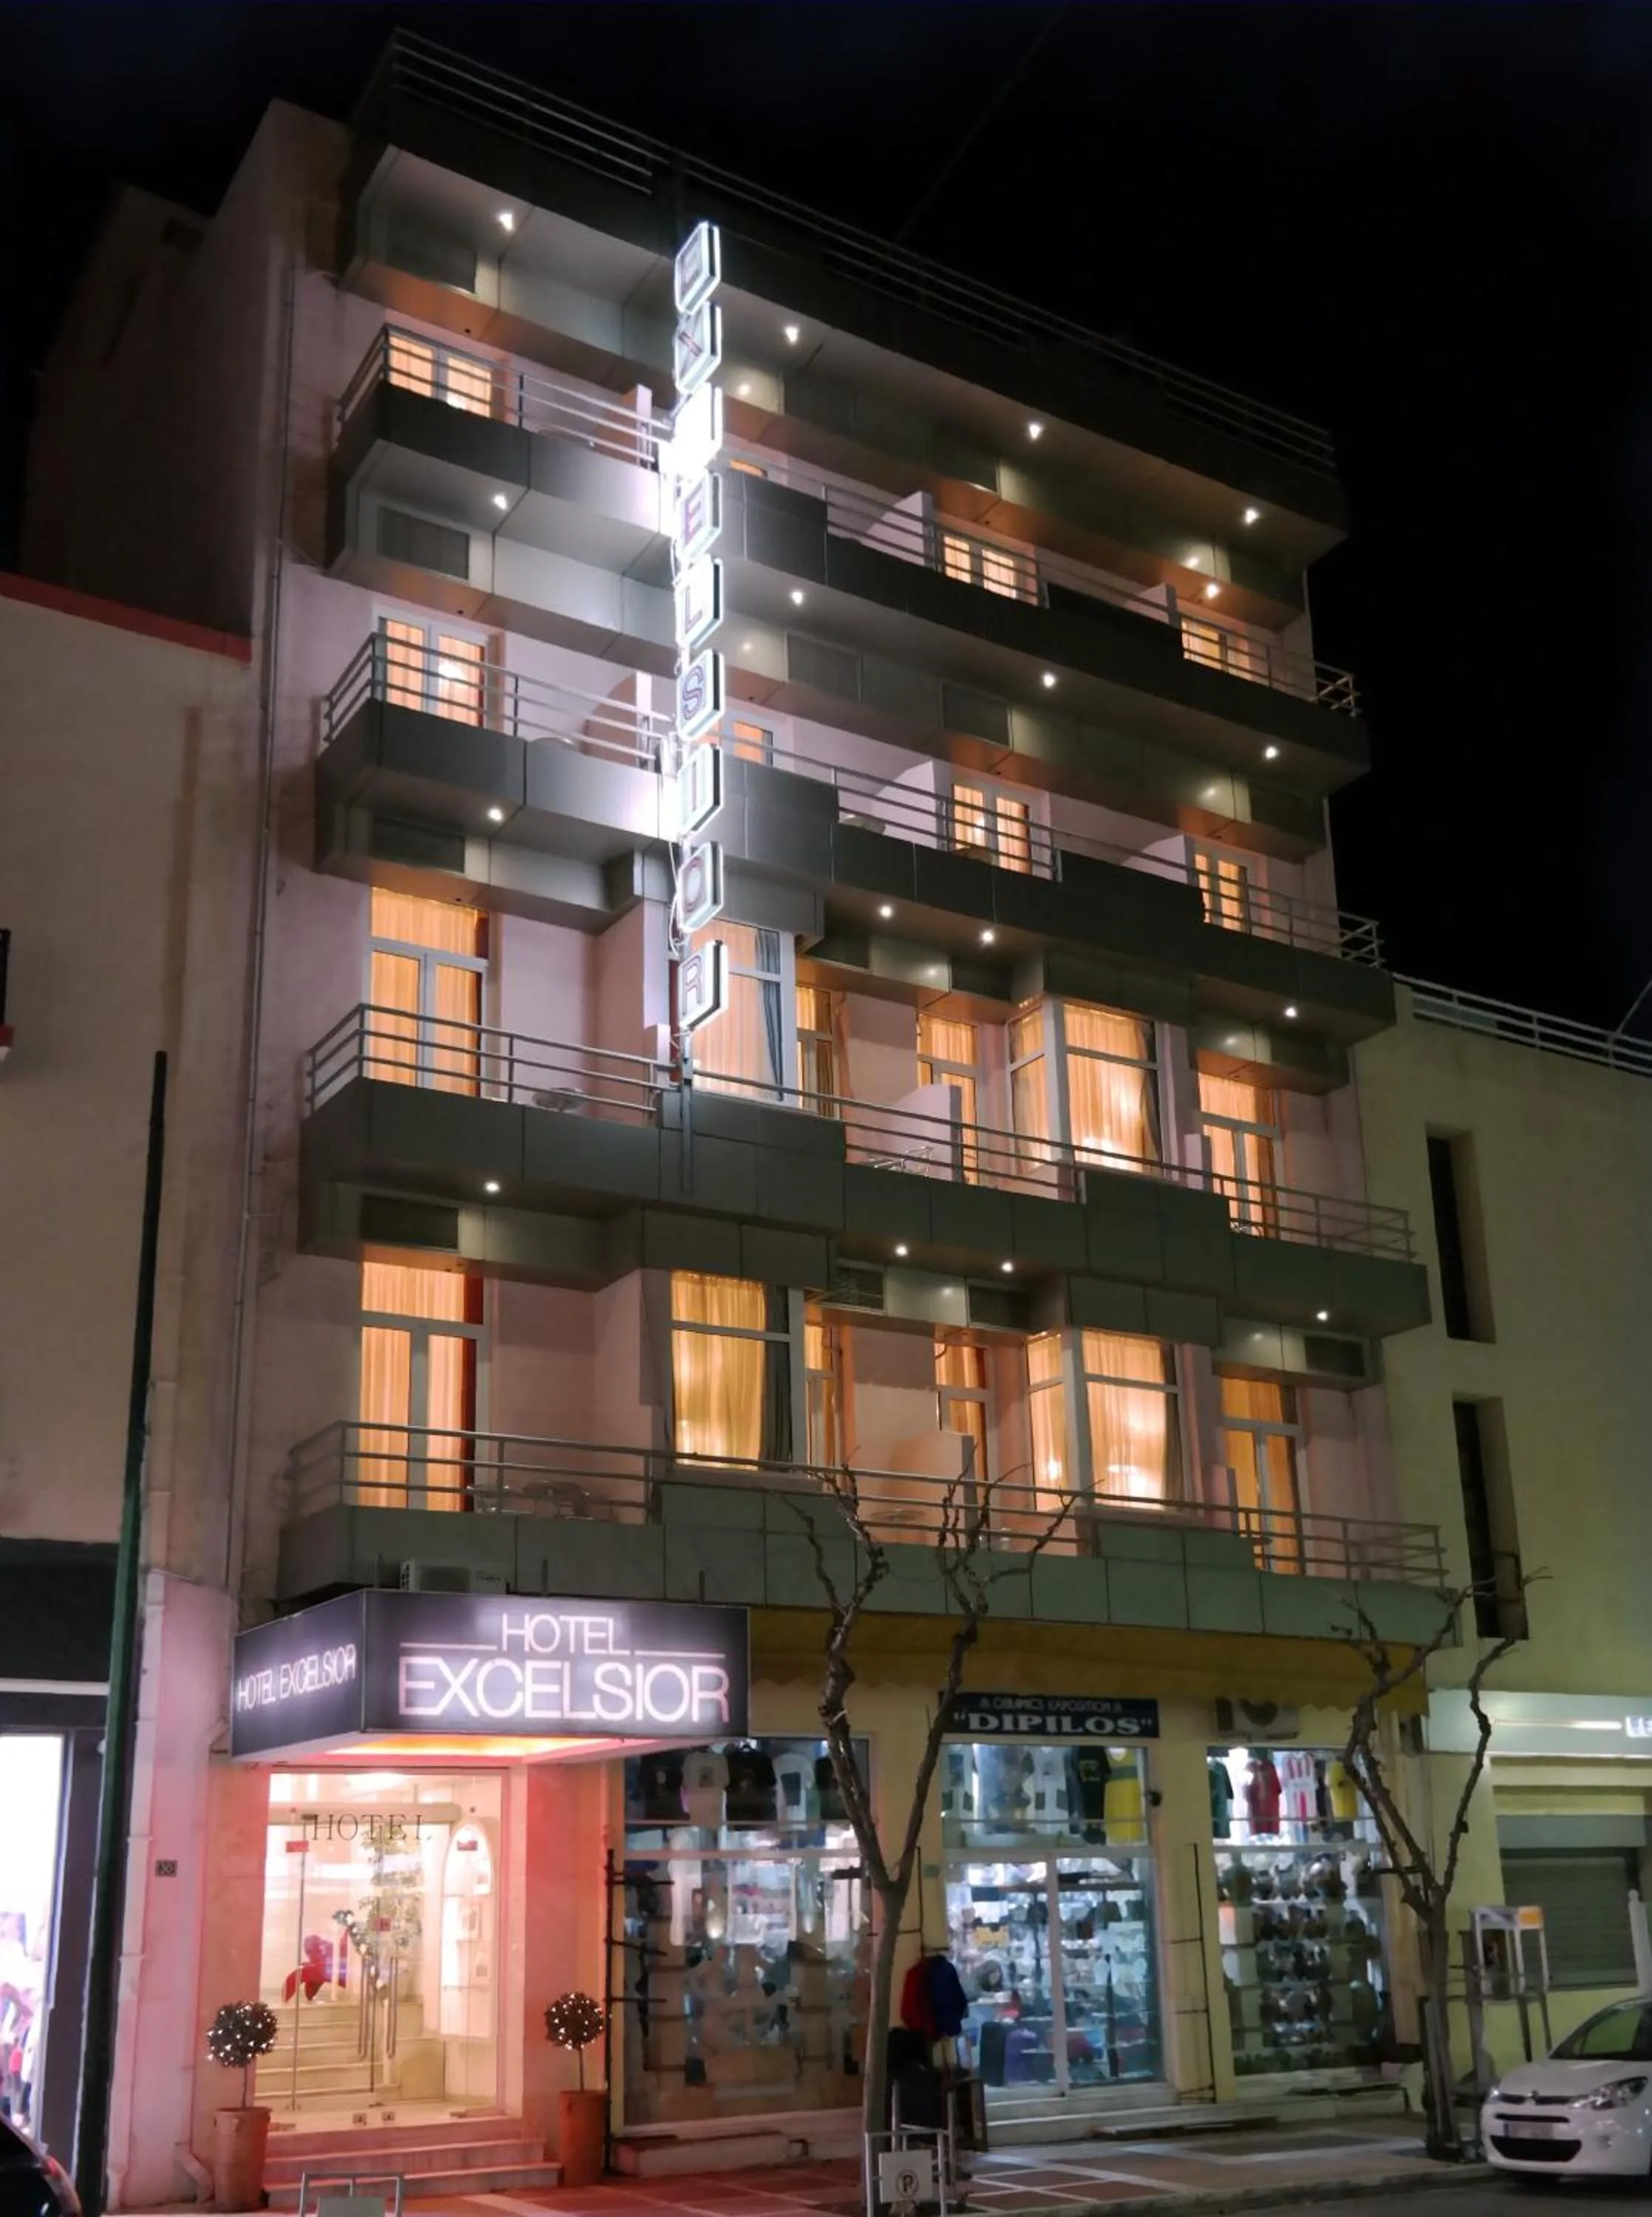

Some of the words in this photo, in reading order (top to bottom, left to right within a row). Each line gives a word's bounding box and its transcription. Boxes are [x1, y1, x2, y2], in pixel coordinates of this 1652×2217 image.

[676, 225, 711, 1024] EXELSIOR
[502, 1614, 630, 1656] HOTEL
[237, 1669, 276, 1712] HOTEL
[280, 1643, 356, 1699] EXCELSIOR
[399, 1656, 729, 1723] EXCELSIOR
[313, 1813, 432, 1840] HOTEL
